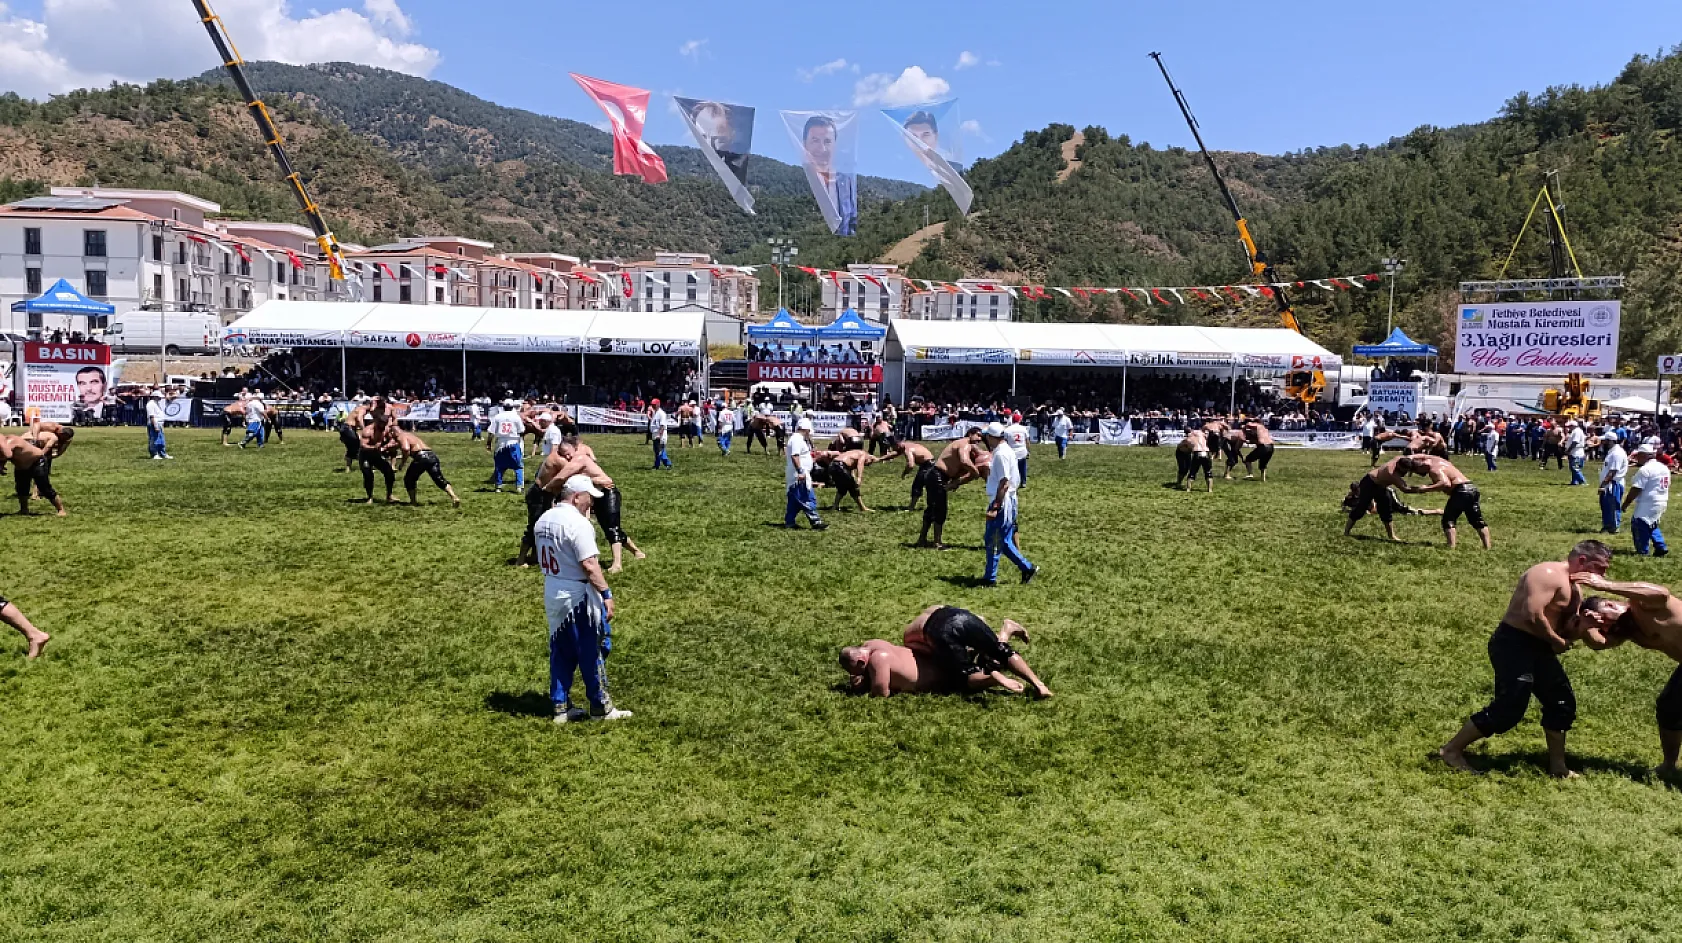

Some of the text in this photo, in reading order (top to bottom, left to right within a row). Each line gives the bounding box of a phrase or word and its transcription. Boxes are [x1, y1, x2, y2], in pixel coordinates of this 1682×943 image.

[1491, 308, 1581, 319] Fethiye Belediyesi
[1487, 319, 1531, 329] Mustafa
[1535, 318, 1585, 329] Kiremitli
[1461, 332, 1522, 351] 3.Yağlı
[643, 342, 672, 353] LOV
[39, 348, 96, 360] BASIN
[759, 366, 814, 379] HAKEM
[28, 385, 75, 393] MUSTAFA
[1015, 433, 1021, 442] 2
[541, 545, 560, 575] 46
